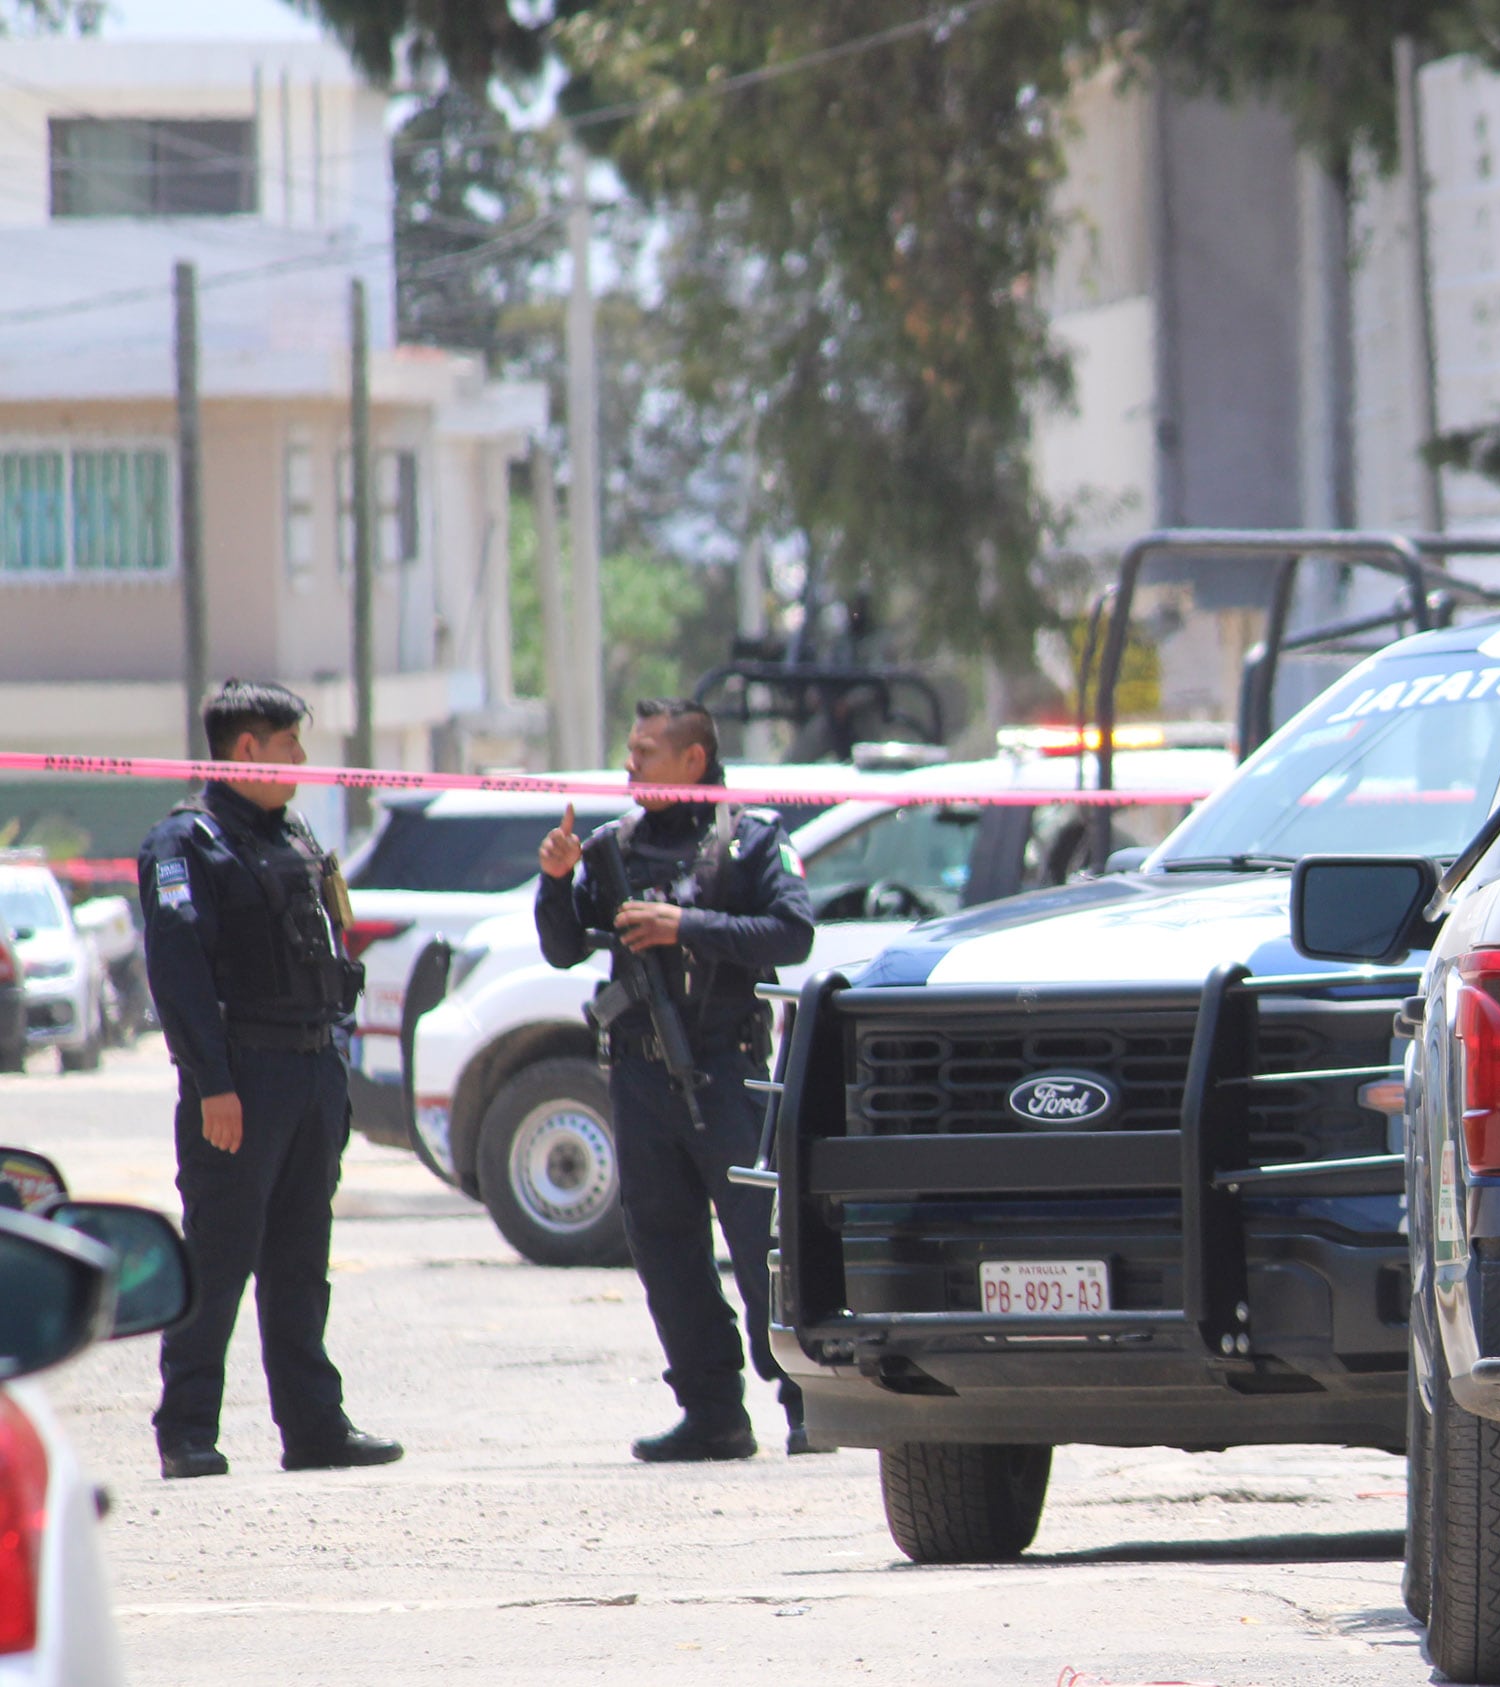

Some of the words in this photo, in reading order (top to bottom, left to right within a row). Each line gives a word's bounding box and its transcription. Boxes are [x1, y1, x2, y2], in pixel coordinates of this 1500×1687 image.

[1028, 1083, 1091, 1115] Ford
[1018, 1265, 1068, 1276] PATRULLA
[984, 1279, 1104, 1313] PB-893-A3
